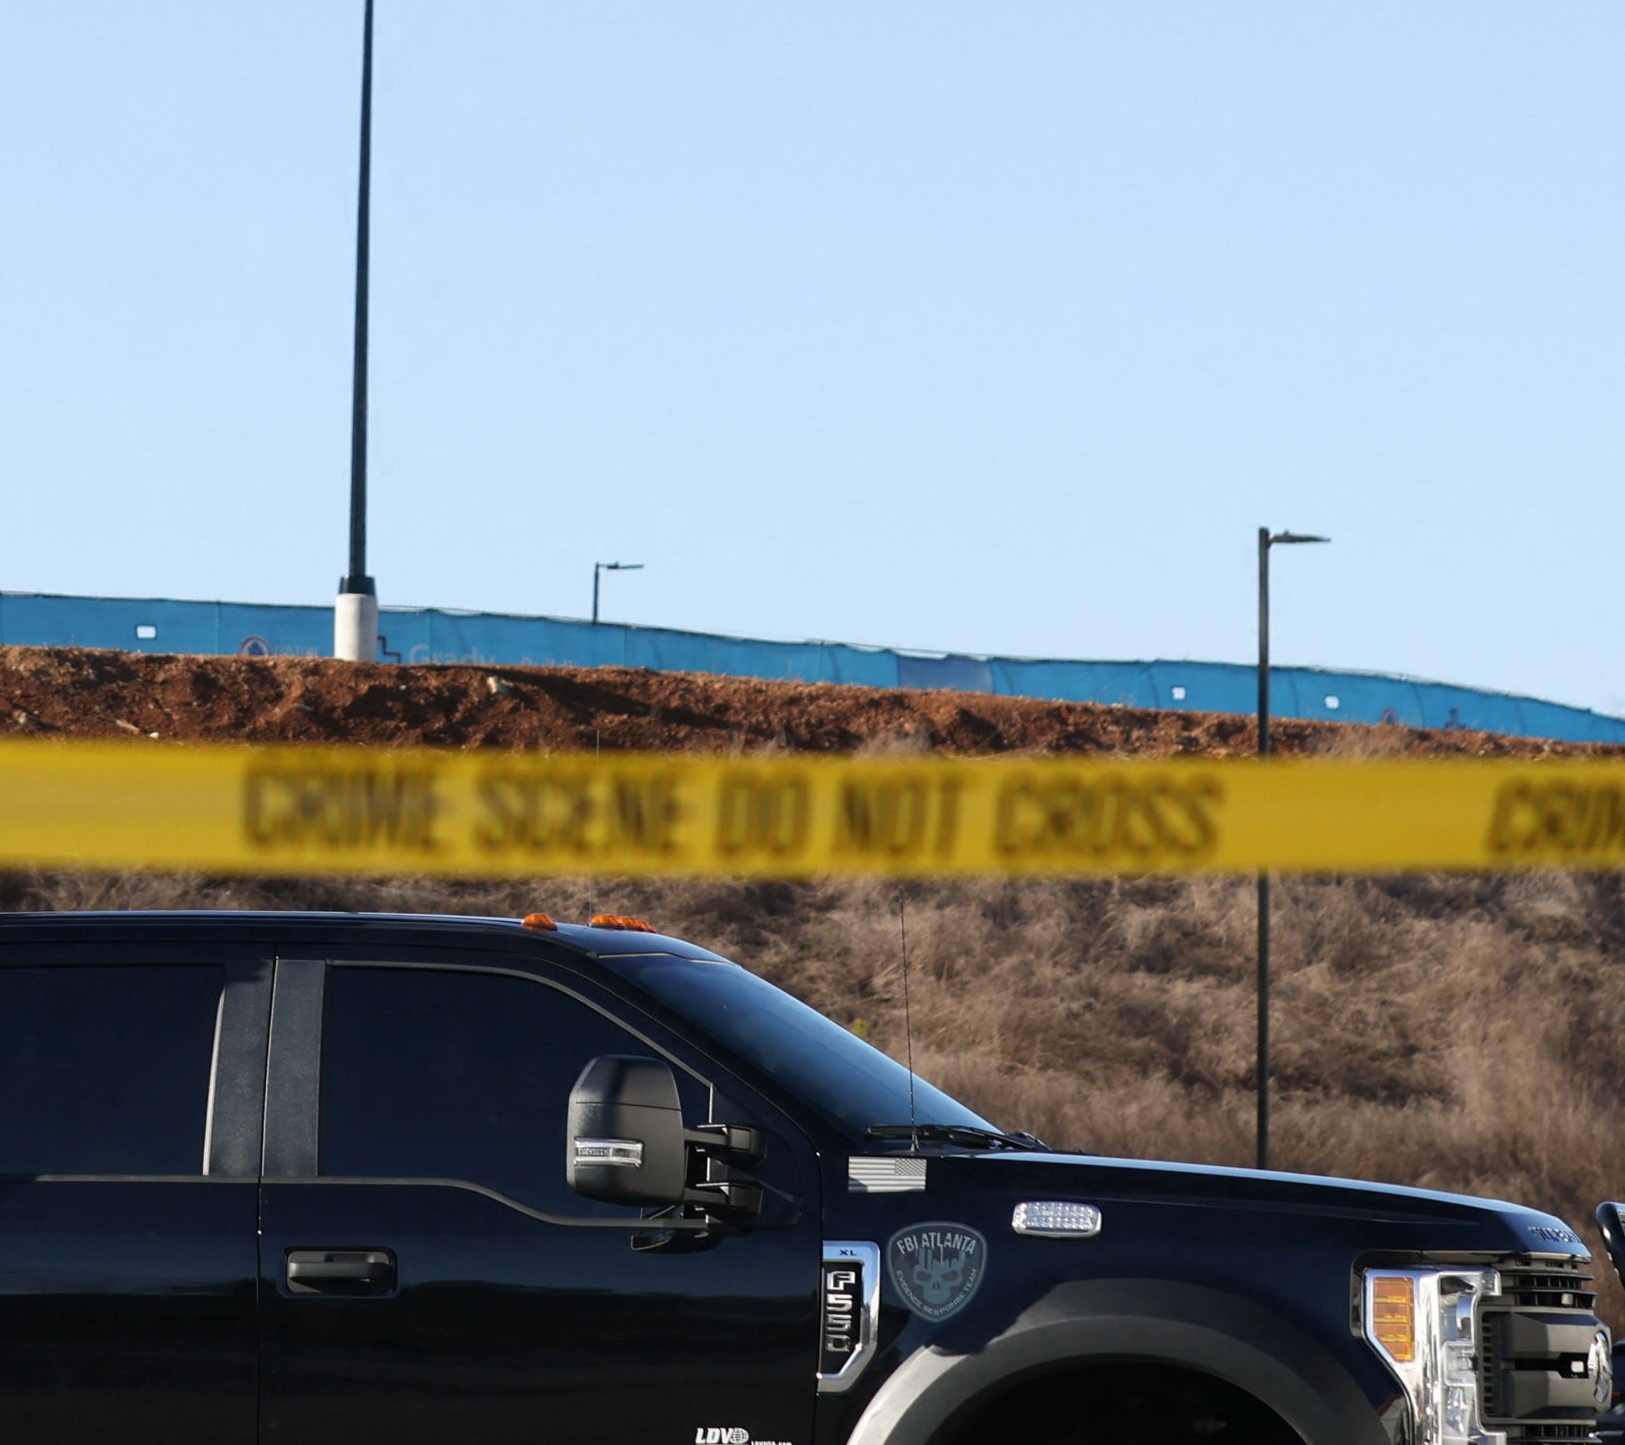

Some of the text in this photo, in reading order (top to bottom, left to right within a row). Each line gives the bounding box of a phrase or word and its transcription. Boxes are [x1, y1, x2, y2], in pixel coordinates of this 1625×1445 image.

[715, 769, 811, 859] DO
[831, 771, 967, 859] NOT
[993, 771, 1227, 860] CROSS
[896, 1231, 977, 1255] FBI ATLANTA
[694, 1427, 735, 1444] LDV
